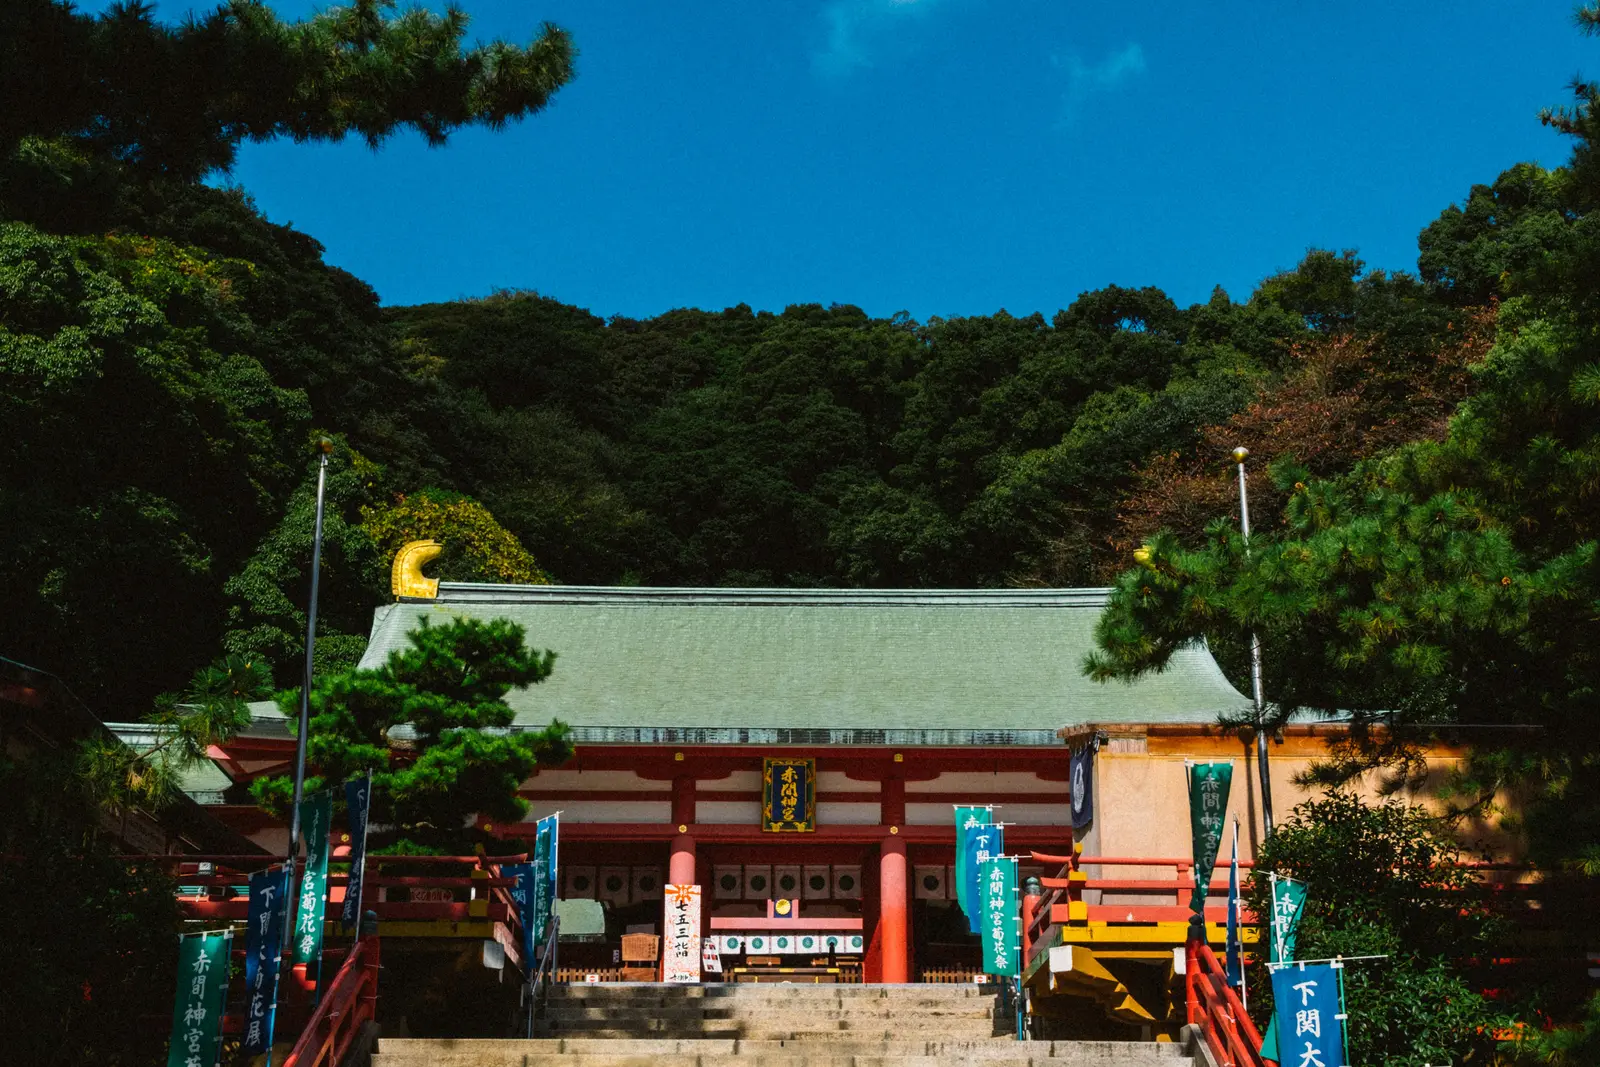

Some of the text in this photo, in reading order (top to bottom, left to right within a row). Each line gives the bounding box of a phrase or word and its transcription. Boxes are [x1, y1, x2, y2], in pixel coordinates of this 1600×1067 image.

[781, 766, 798, 820] 赤間神宮
[675, 900, 690, 957] 七五三詣
[989, 867, 1008, 969] 赤間神宮菊花祭
